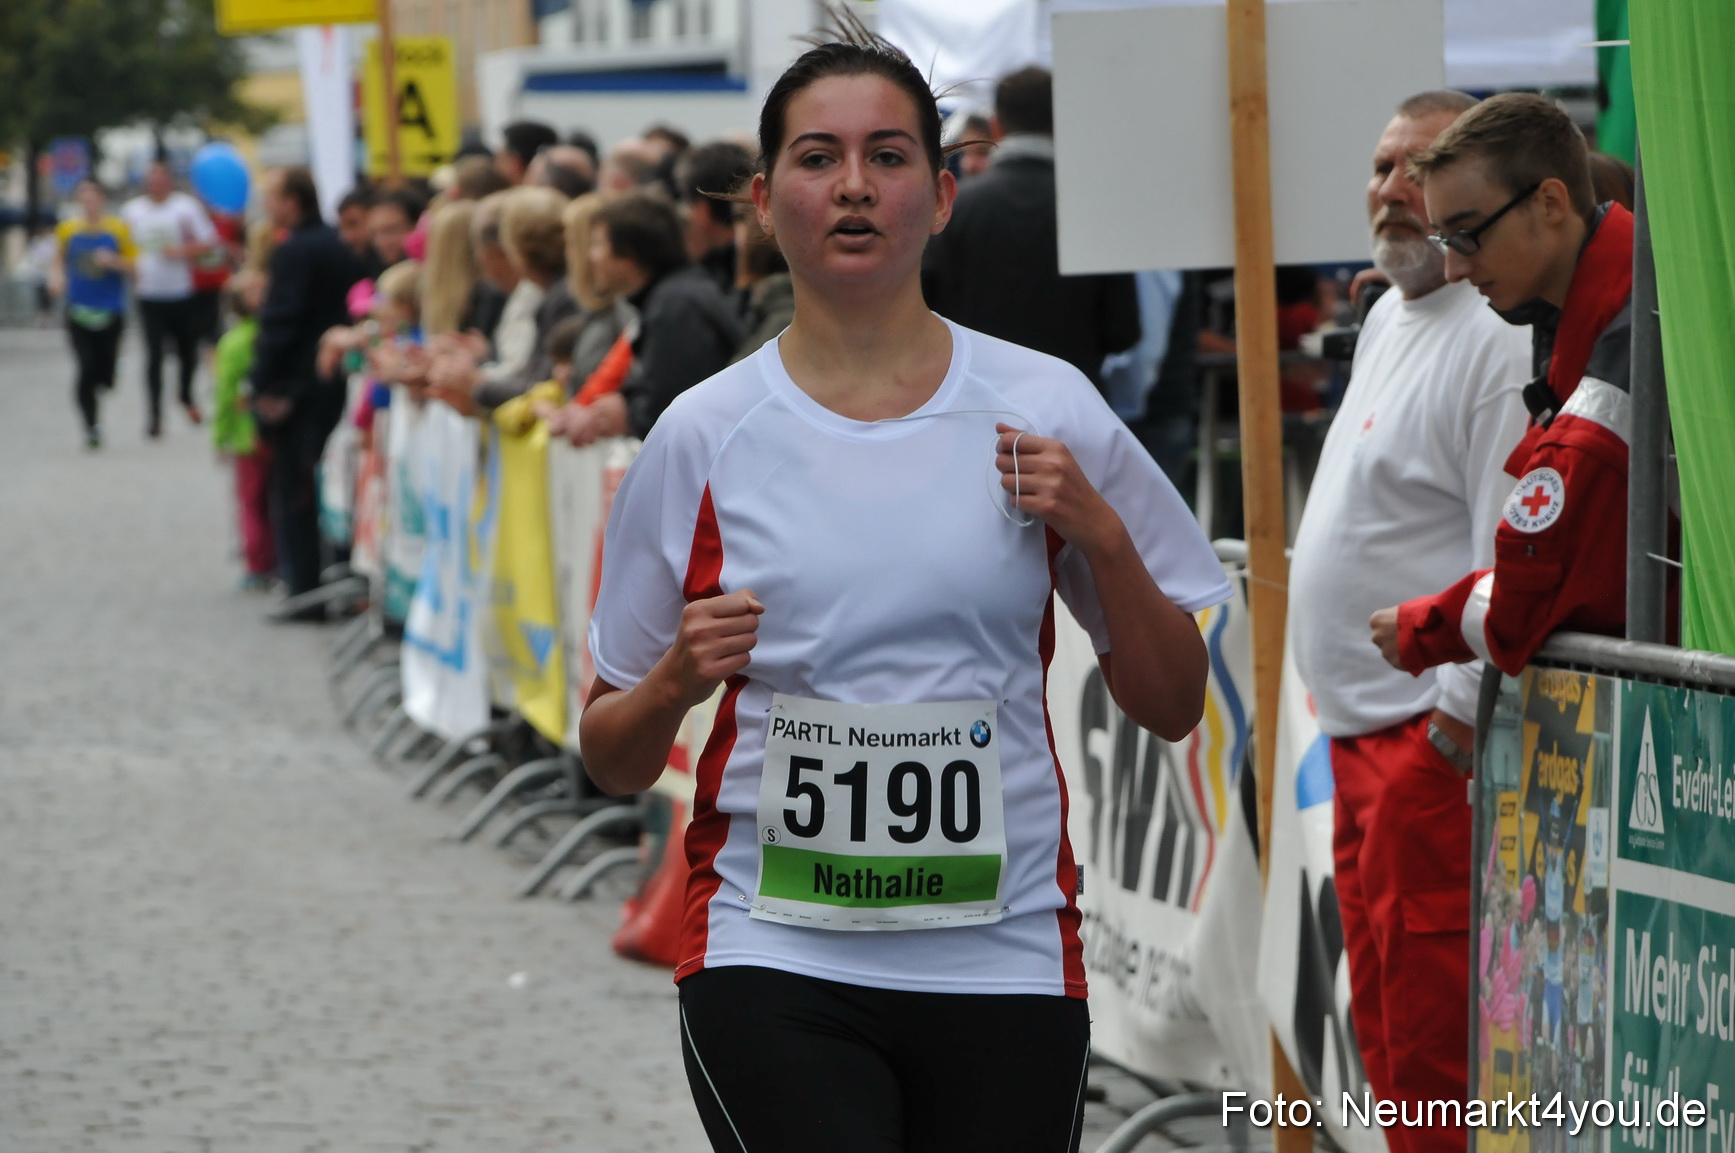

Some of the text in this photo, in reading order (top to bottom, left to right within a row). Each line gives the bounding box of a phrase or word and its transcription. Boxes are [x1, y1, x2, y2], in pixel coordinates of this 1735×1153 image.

[772, 717, 962, 748] PARTL Neumarkt
[782, 755, 981, 844] 5190
[813, 862, 944, 898] Nathalie
[1624, 927, 1691, 1027] Mehr
